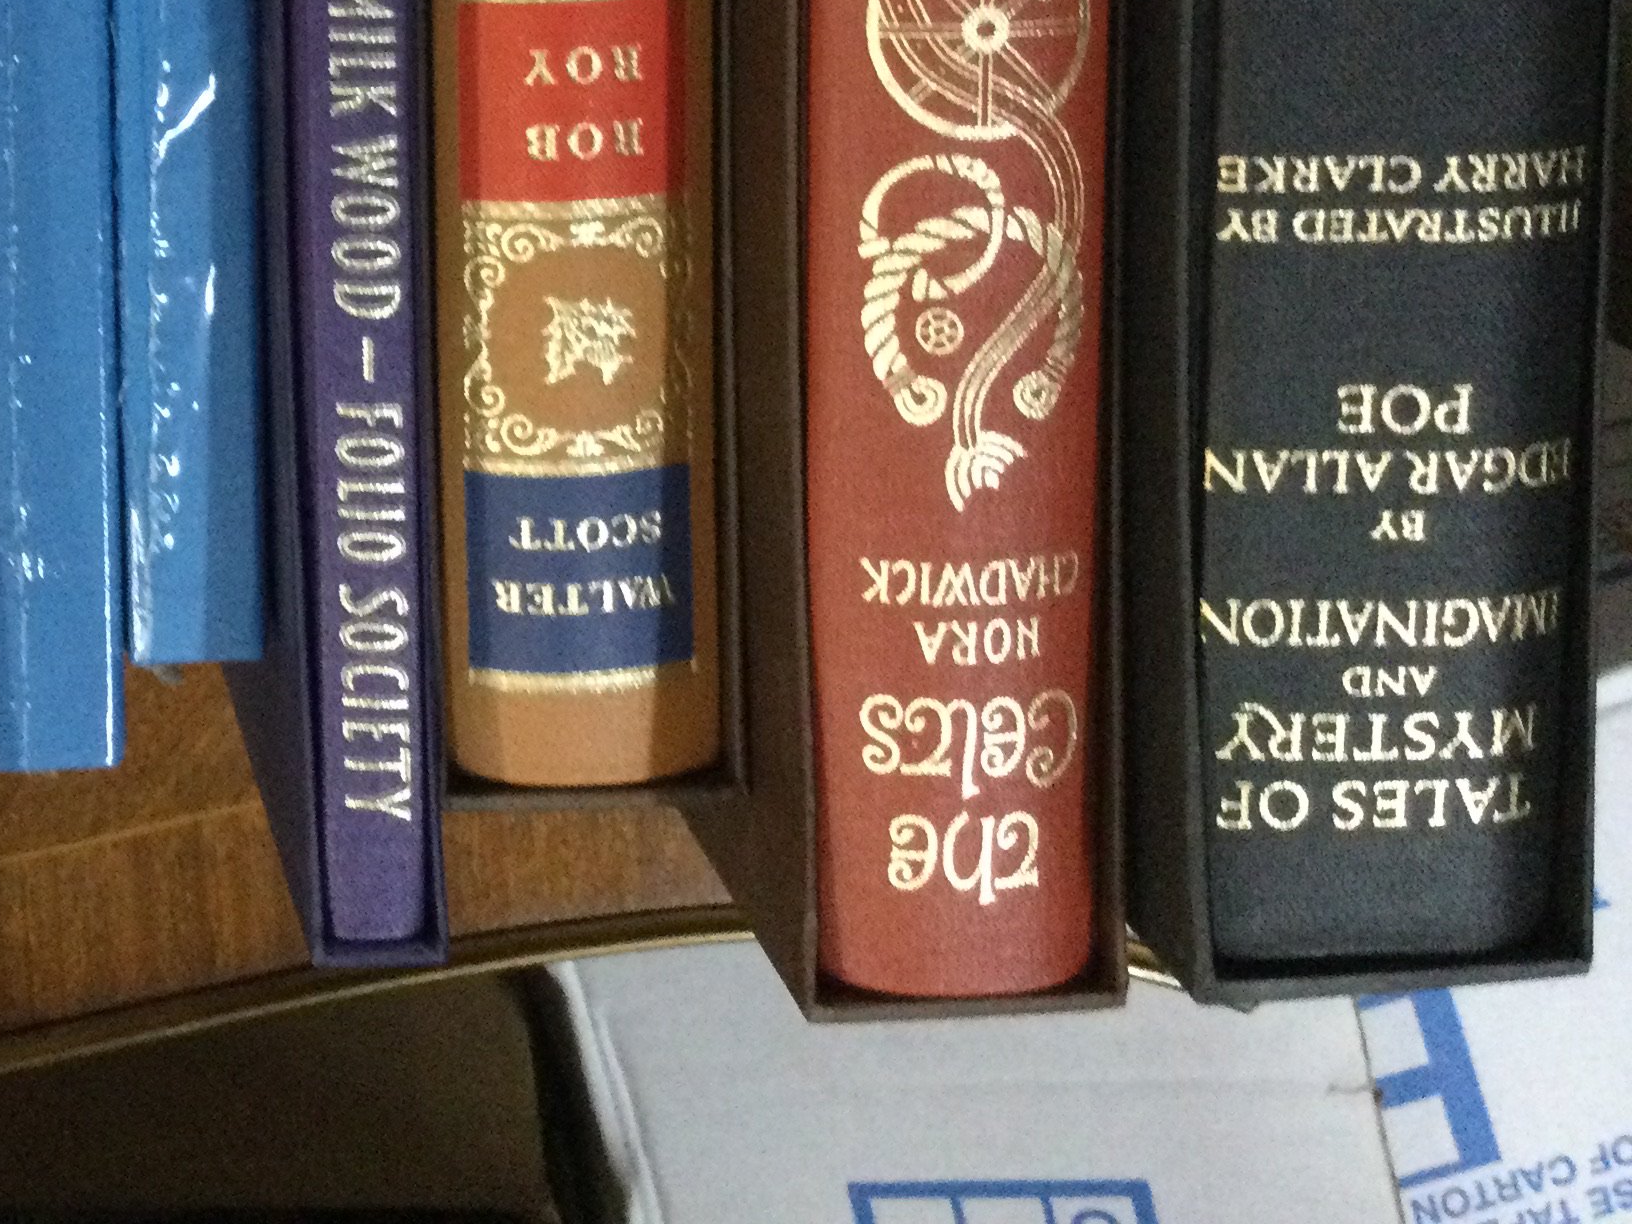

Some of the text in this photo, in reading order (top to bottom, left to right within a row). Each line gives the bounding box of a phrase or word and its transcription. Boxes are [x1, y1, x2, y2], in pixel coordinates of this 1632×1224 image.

[524, 42, 643, 86] ROY
[525, 118, 644, 162] ROB
[1217, 146, 1586, 194] HARRY CLARKE
[330, 134, 401, 320] WOOD
[1216, 199, 1581, 243] ILLUSTRATED BY
[1337, 383, 1474, 436] POE
[335, 401, 406, 562] FOLIO
[1203, 446, 1393, 495] ALLAN
[508, 510, 662, 553] SCOTT
[1370, 509, 1426, 542] BY
[492, 574, 675, 617] WALTER
[860, 550, 1078, 607] CHADWICK
[913, 615, 1040, 665] NORA
[1200, 591, 1559, 647] IMAGINATION
[339, 583, 412, 822] SOCIETY
[1342, 664, 1438, 698] AND
[1215, 702, 1536, 762] MYSTERY
[1216, 775, 1530, 830] TALES OF
[1411, 1155, 1576, 1224] CARTON
